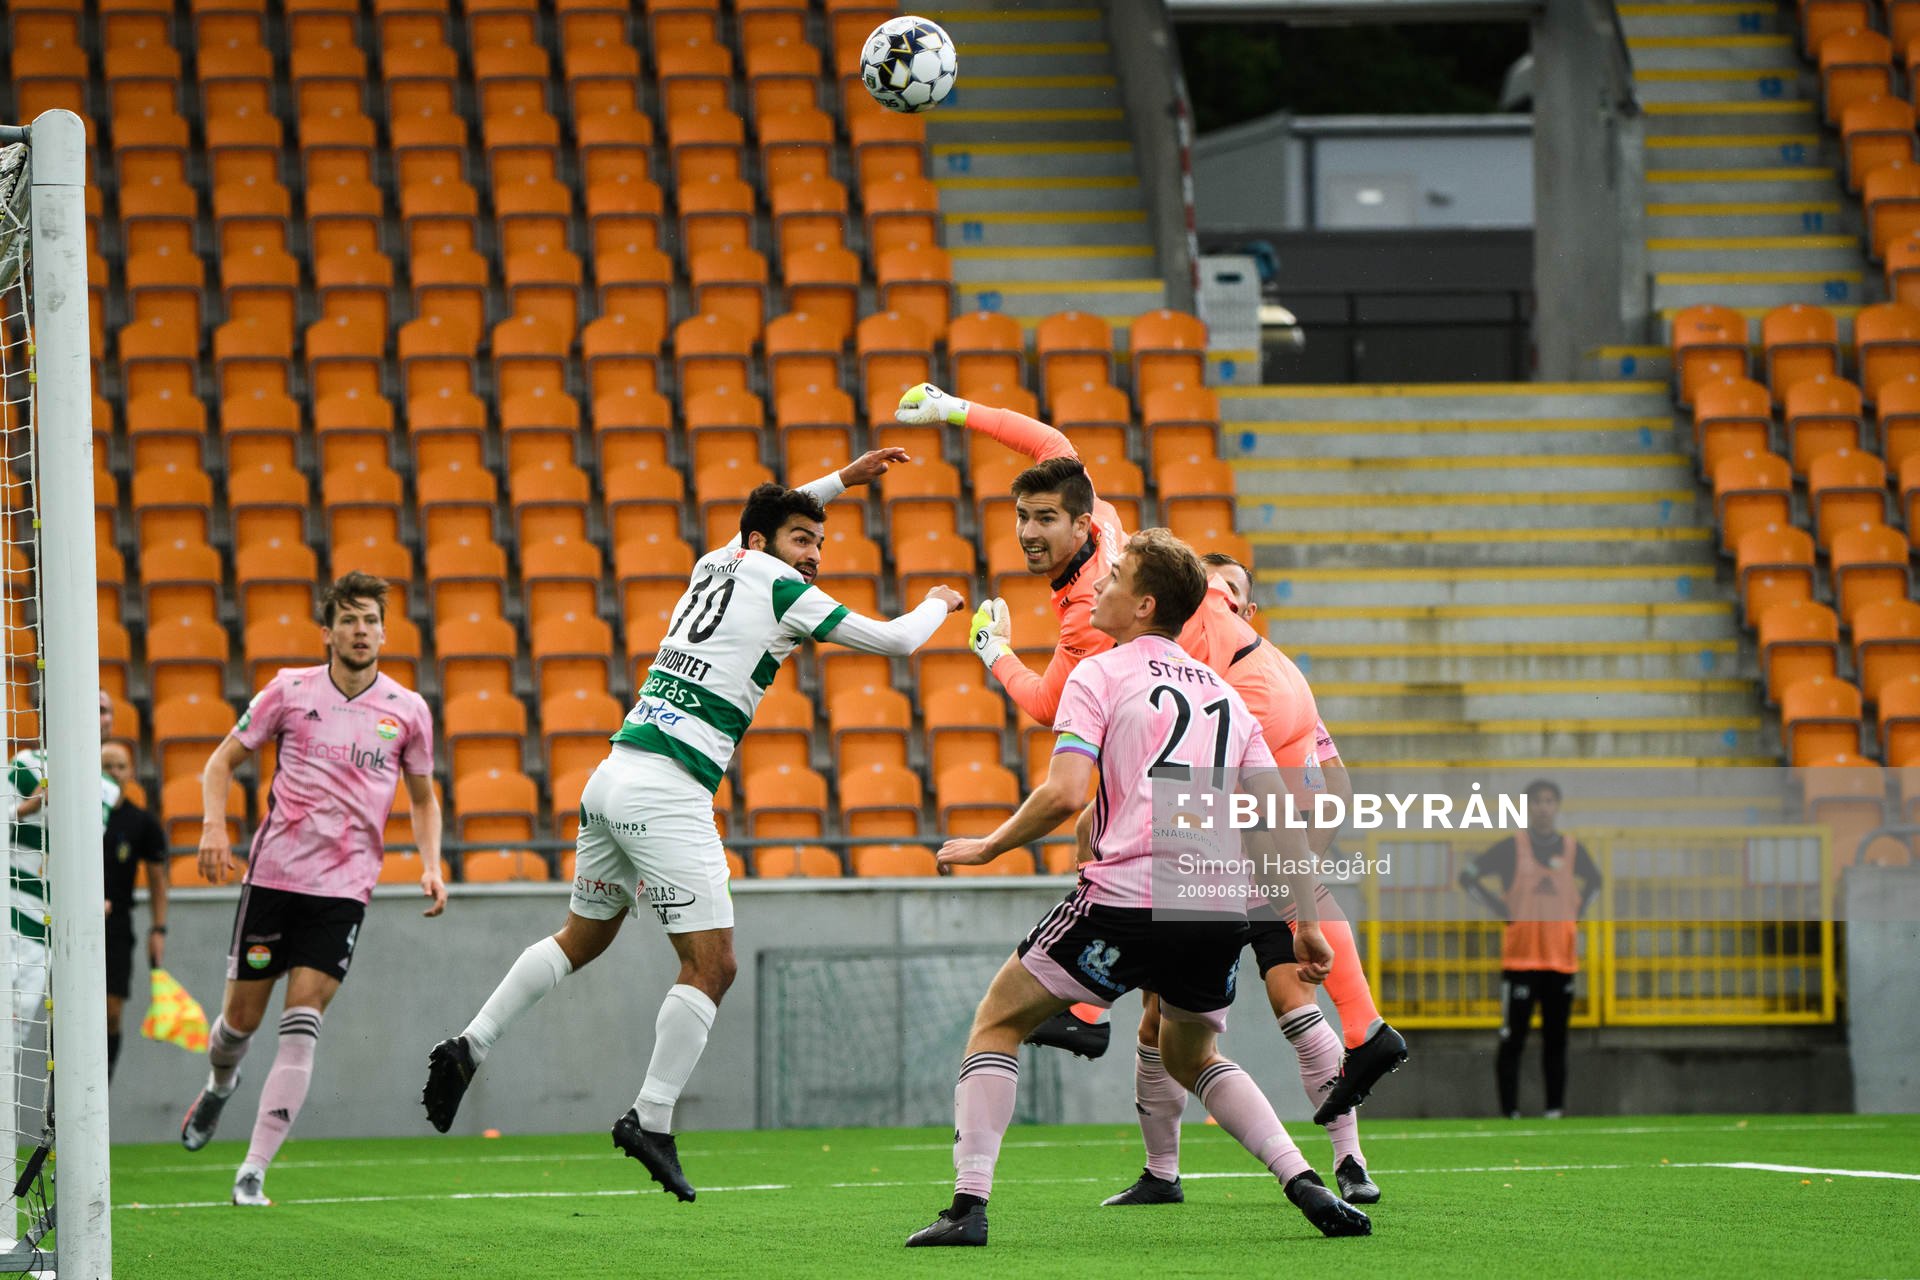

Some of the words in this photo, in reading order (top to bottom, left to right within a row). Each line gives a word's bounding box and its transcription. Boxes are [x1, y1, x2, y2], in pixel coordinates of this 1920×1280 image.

[668, 574, 736, 644] 10
[1148, 660, 1219, 688] STYFFE
[303, 736, 385, 769] fastlink
[1148, 684, 1231, 791] 21
